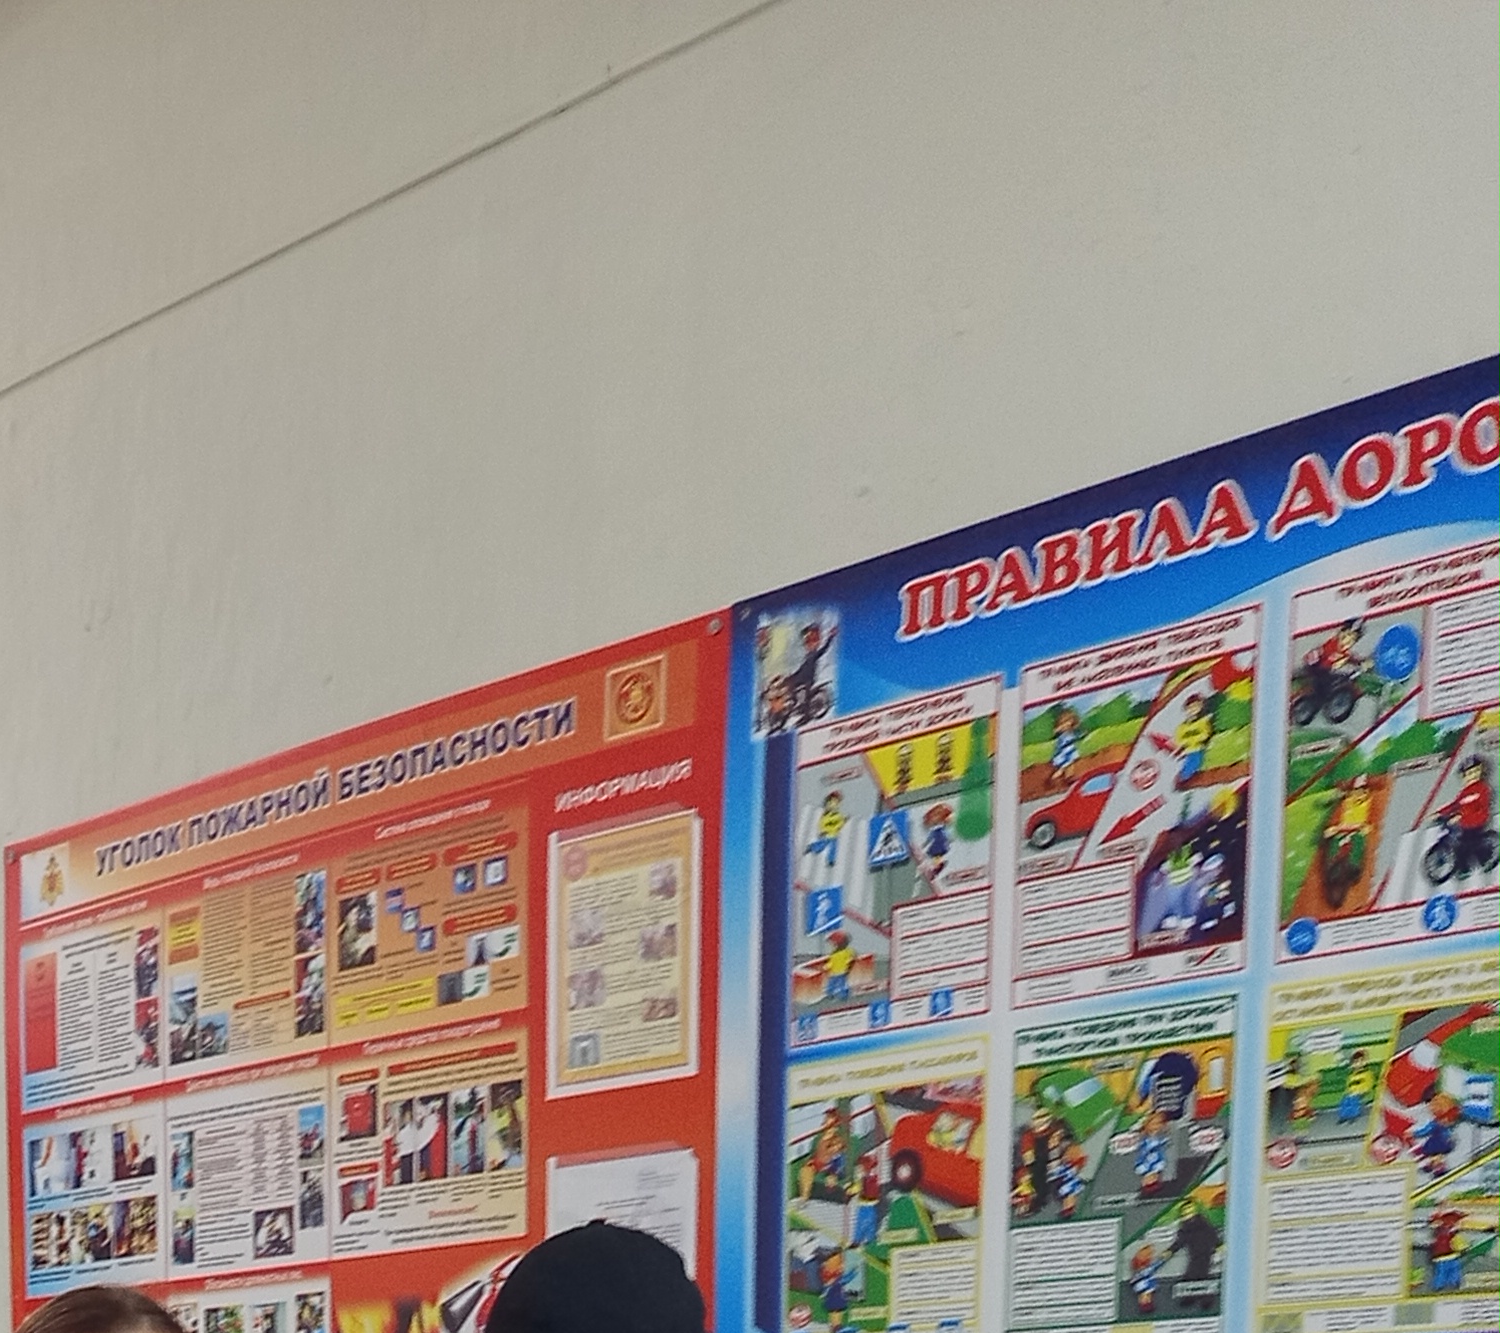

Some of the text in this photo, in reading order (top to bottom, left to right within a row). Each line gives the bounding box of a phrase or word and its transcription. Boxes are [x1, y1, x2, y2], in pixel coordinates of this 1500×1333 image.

[898, 482, 1256, 640] ПРАВИЛА
[1272, 400, 1500, 536] ДОРО
[95, 820, 182, 877] УГОЛОК
[187, 772, 331, 850] ПОЖАРНОЙ
[336, 698, 577, 804] БЕЗОПАСНОСТИ
